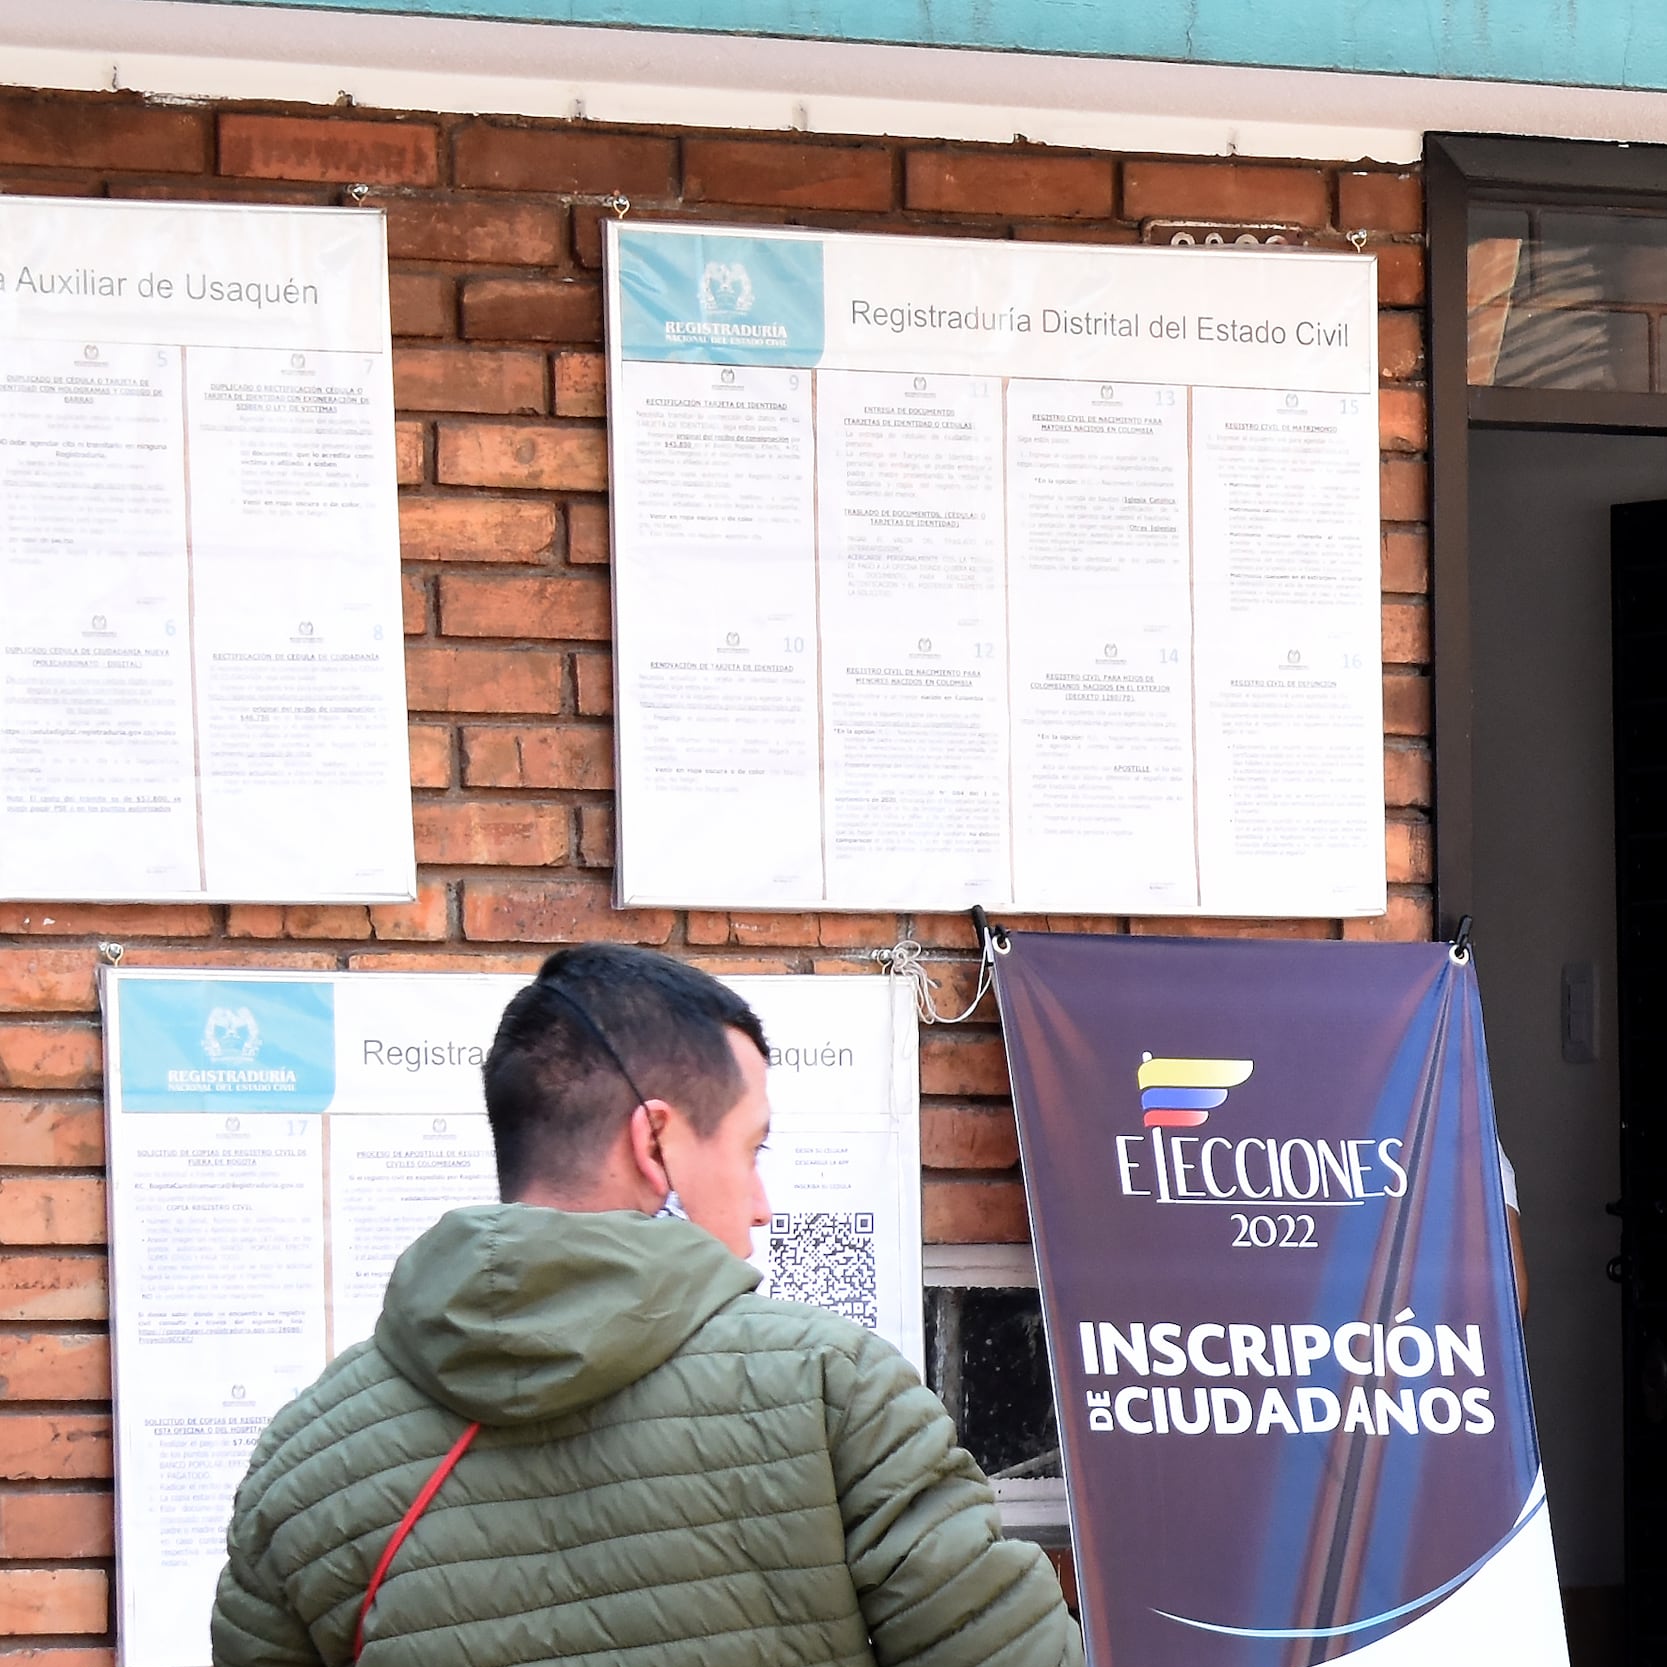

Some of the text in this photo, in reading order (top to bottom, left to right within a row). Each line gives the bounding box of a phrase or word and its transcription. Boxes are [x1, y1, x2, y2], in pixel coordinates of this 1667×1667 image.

[15, 266, 127, 297] Auxiliar
[137, 272, 174, 299] de
[185, 274, 320, 309] Usaquén
[665, 321, 788, 338] REGISTRADURÍA
[851, 300, 1350, 349] Registraduría Distrital del Estado Civil
[168, 1067, 297, 1083] REGISTRADURÍA
[364, 1039, 853, 1072] Registra aquén
[168, 1083, 296, 1092] NACIONAL DEL ESTADO CIVIL
[1115, 1127, 1409, 1203] ELECCIONES
[1231, 1213, 1319, 1248] 2022
[1079, 1307, 1486, 1377] INSCRIPCIÓN
[1086, 1386, 1496, 1436] DE CIUDADANOS
